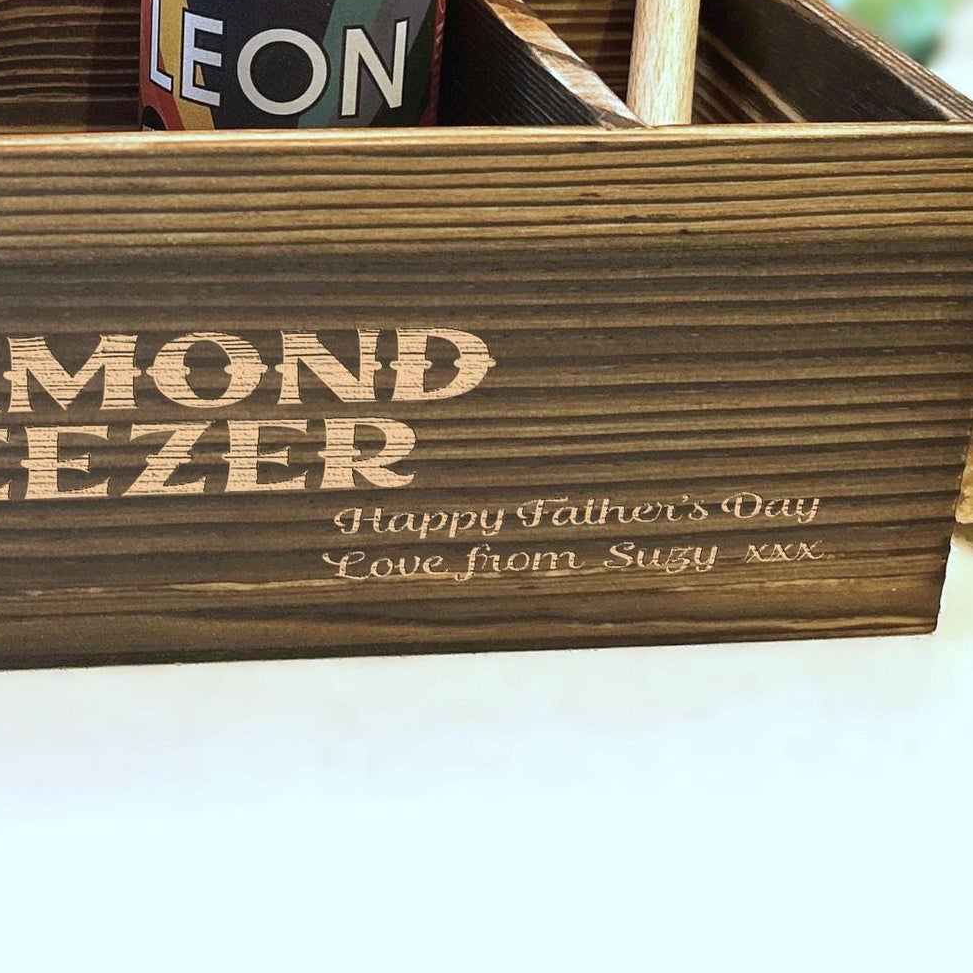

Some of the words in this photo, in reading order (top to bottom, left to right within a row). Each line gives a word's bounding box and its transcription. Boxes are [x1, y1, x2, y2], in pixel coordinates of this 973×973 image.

[333, 506, 505, 539] Happy
[516, 494, 709, 528] Father's
[721, 491, 822, 525] Day
[322, 550, 449, 580] Love
[454, 543, 585, 583] from
[602, 540, 720, 574] Suzy
[744, 538, 825, 564] xxx
